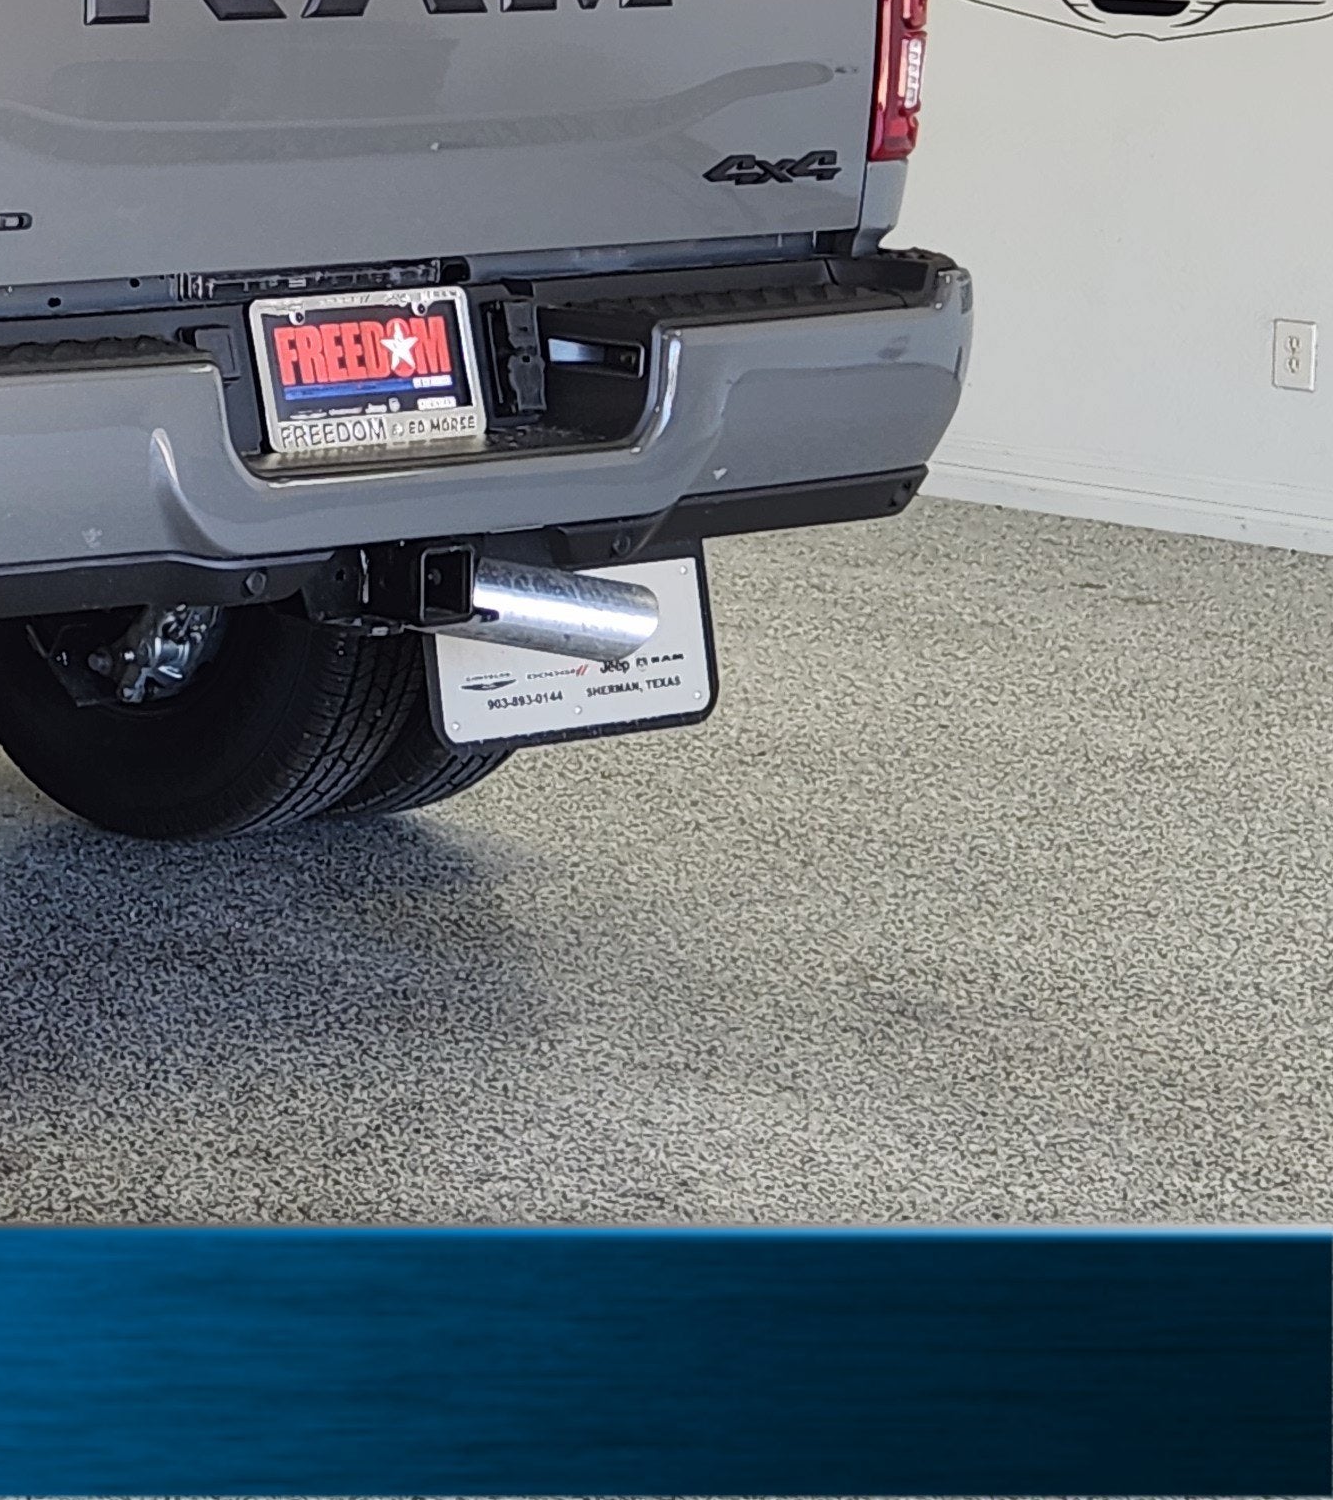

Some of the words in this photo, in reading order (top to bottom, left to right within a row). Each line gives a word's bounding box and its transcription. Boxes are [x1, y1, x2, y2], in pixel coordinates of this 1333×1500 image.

[702, 150, 842, 186] 4x4
[273, 315, 453, 386] FREEDOM
[280, 417, 388, 450] FREEDOM
[429, 415, 476, 434] MORSE
[644, 674, 682, 690] TEXAS
